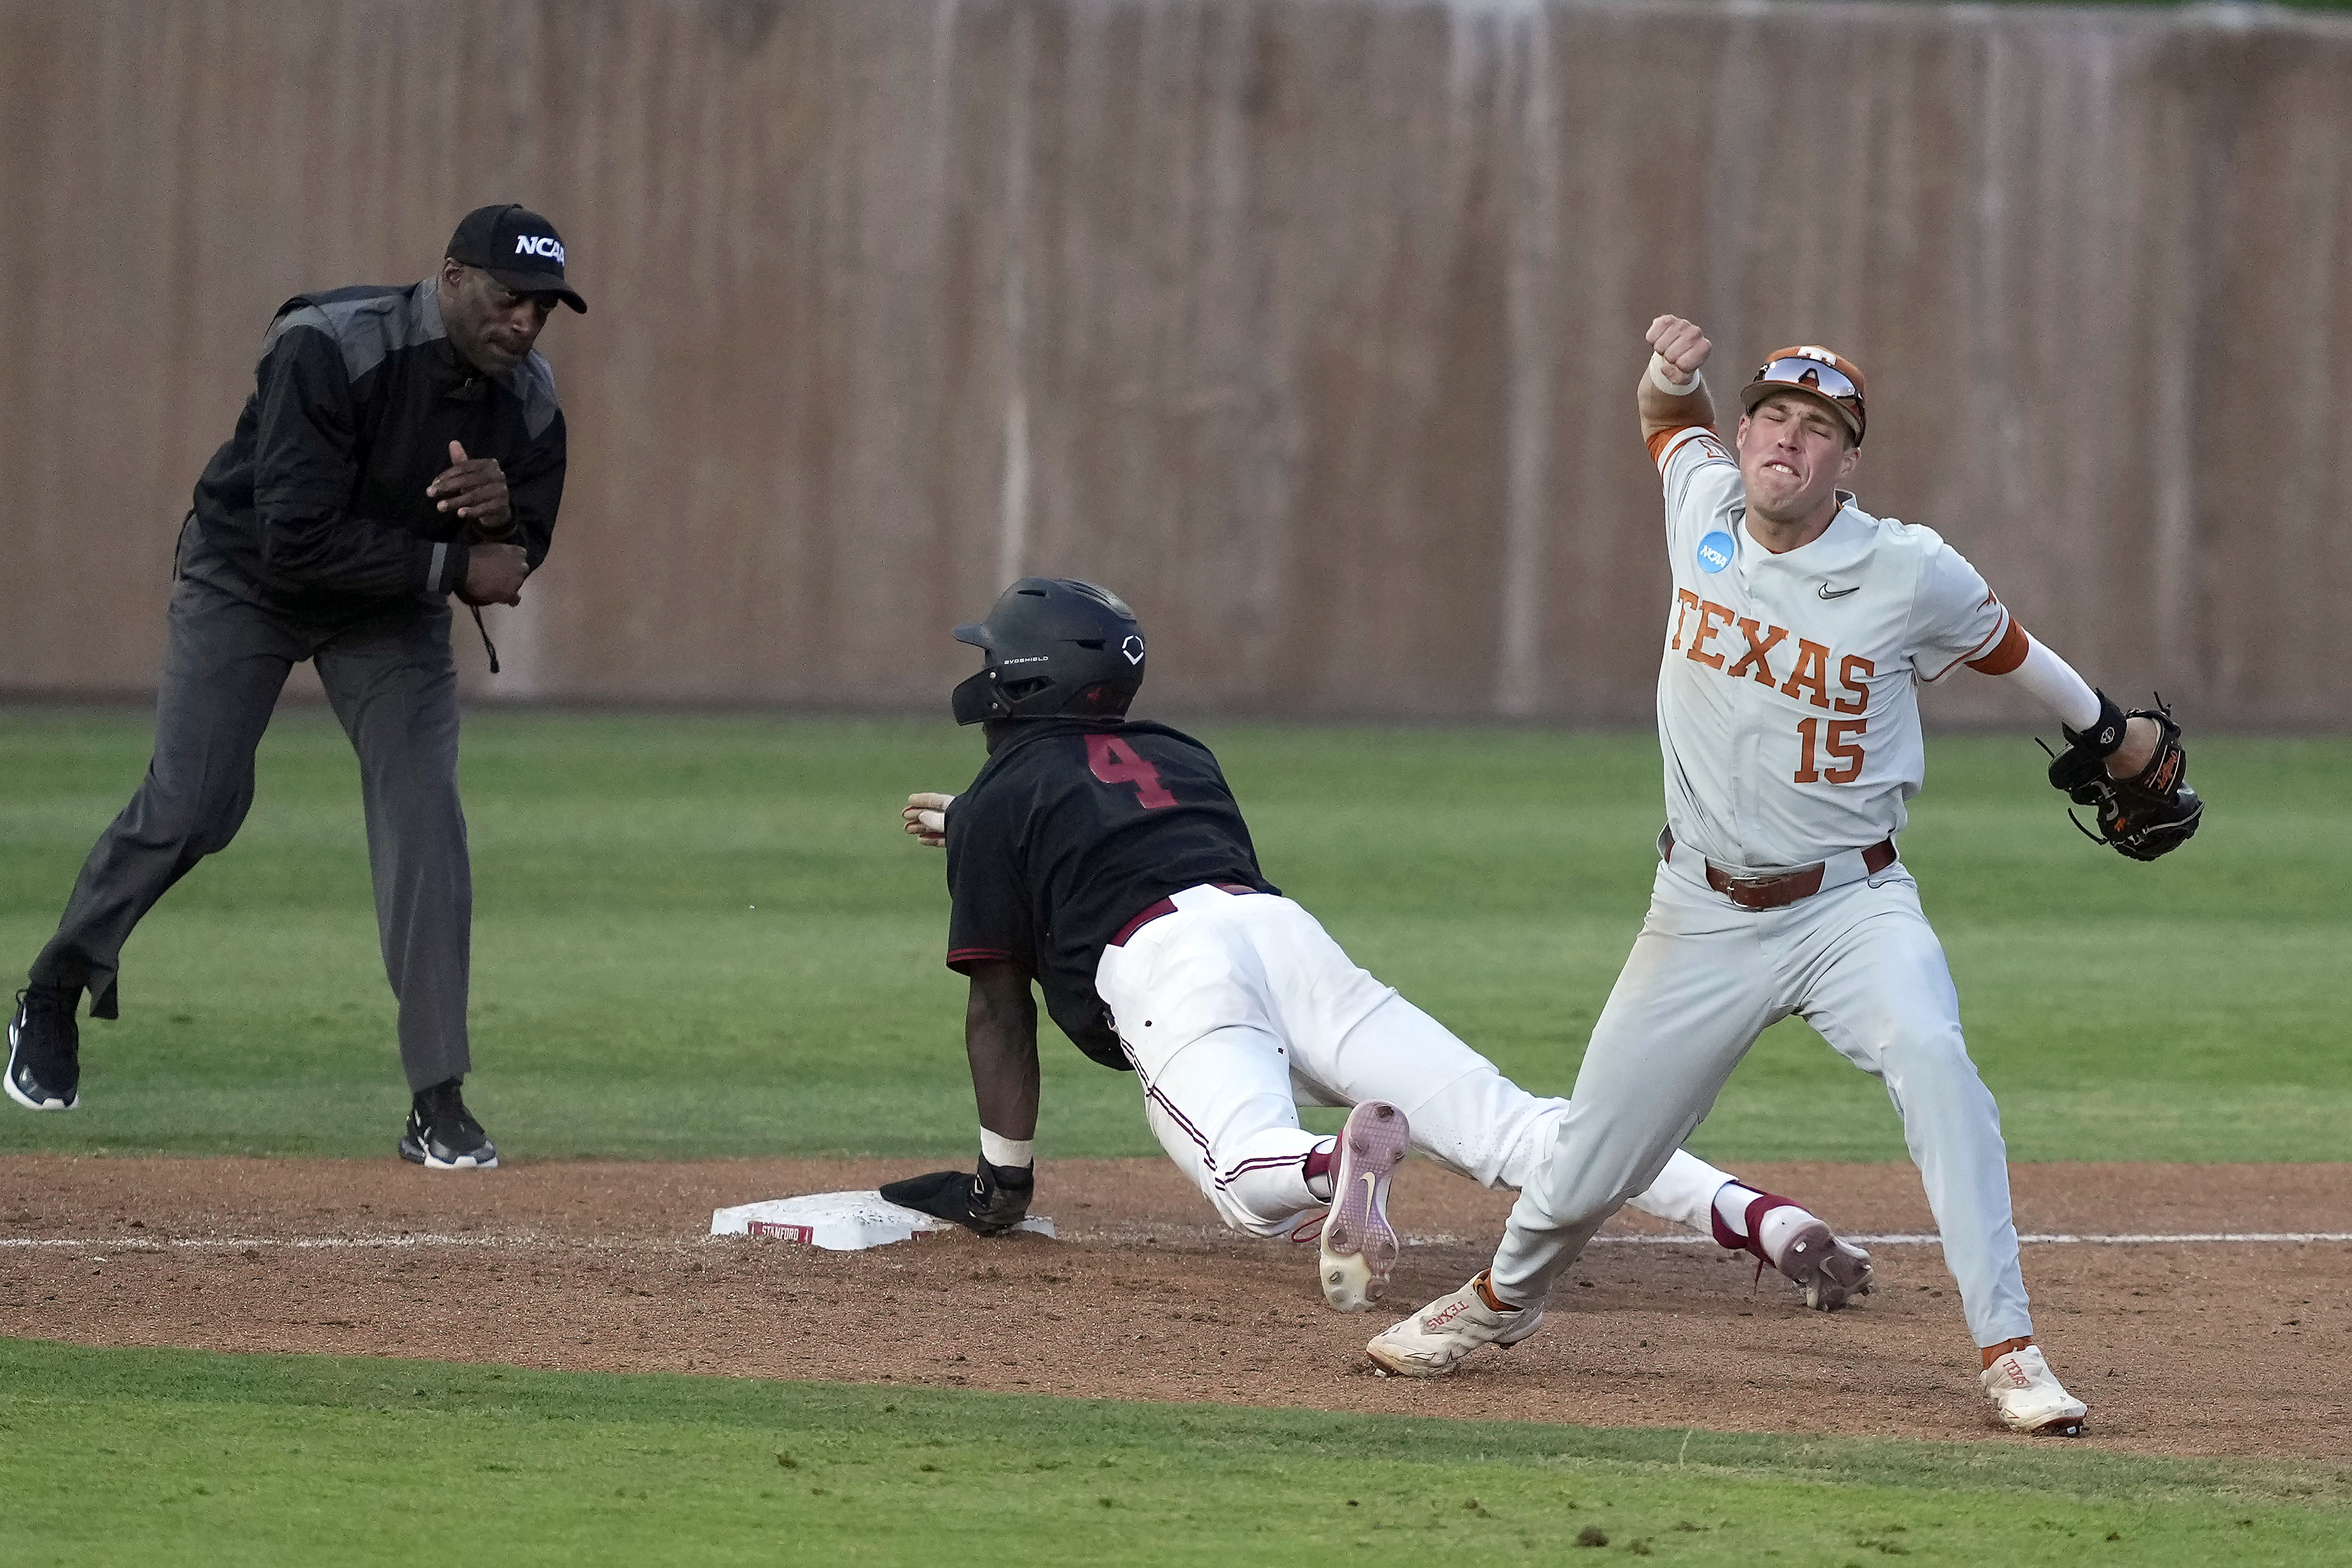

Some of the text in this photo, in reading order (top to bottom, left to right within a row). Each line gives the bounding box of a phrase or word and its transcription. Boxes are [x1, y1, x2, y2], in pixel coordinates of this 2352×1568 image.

[515, 235, 565, 266] NCAA
[1700, 545, 1727, 568] NCAA
[1004, 656, 1048, 665] EVOSHIELD
[1672, 588, 1875, 715] TEXAS
[1794, 718, 1868, 784] 15
[1084, 733, 1178, 810] 4
[762, 1225, 799, 1241] STANFORD
[1426, 1301, 1470, 1331] TEXAS
